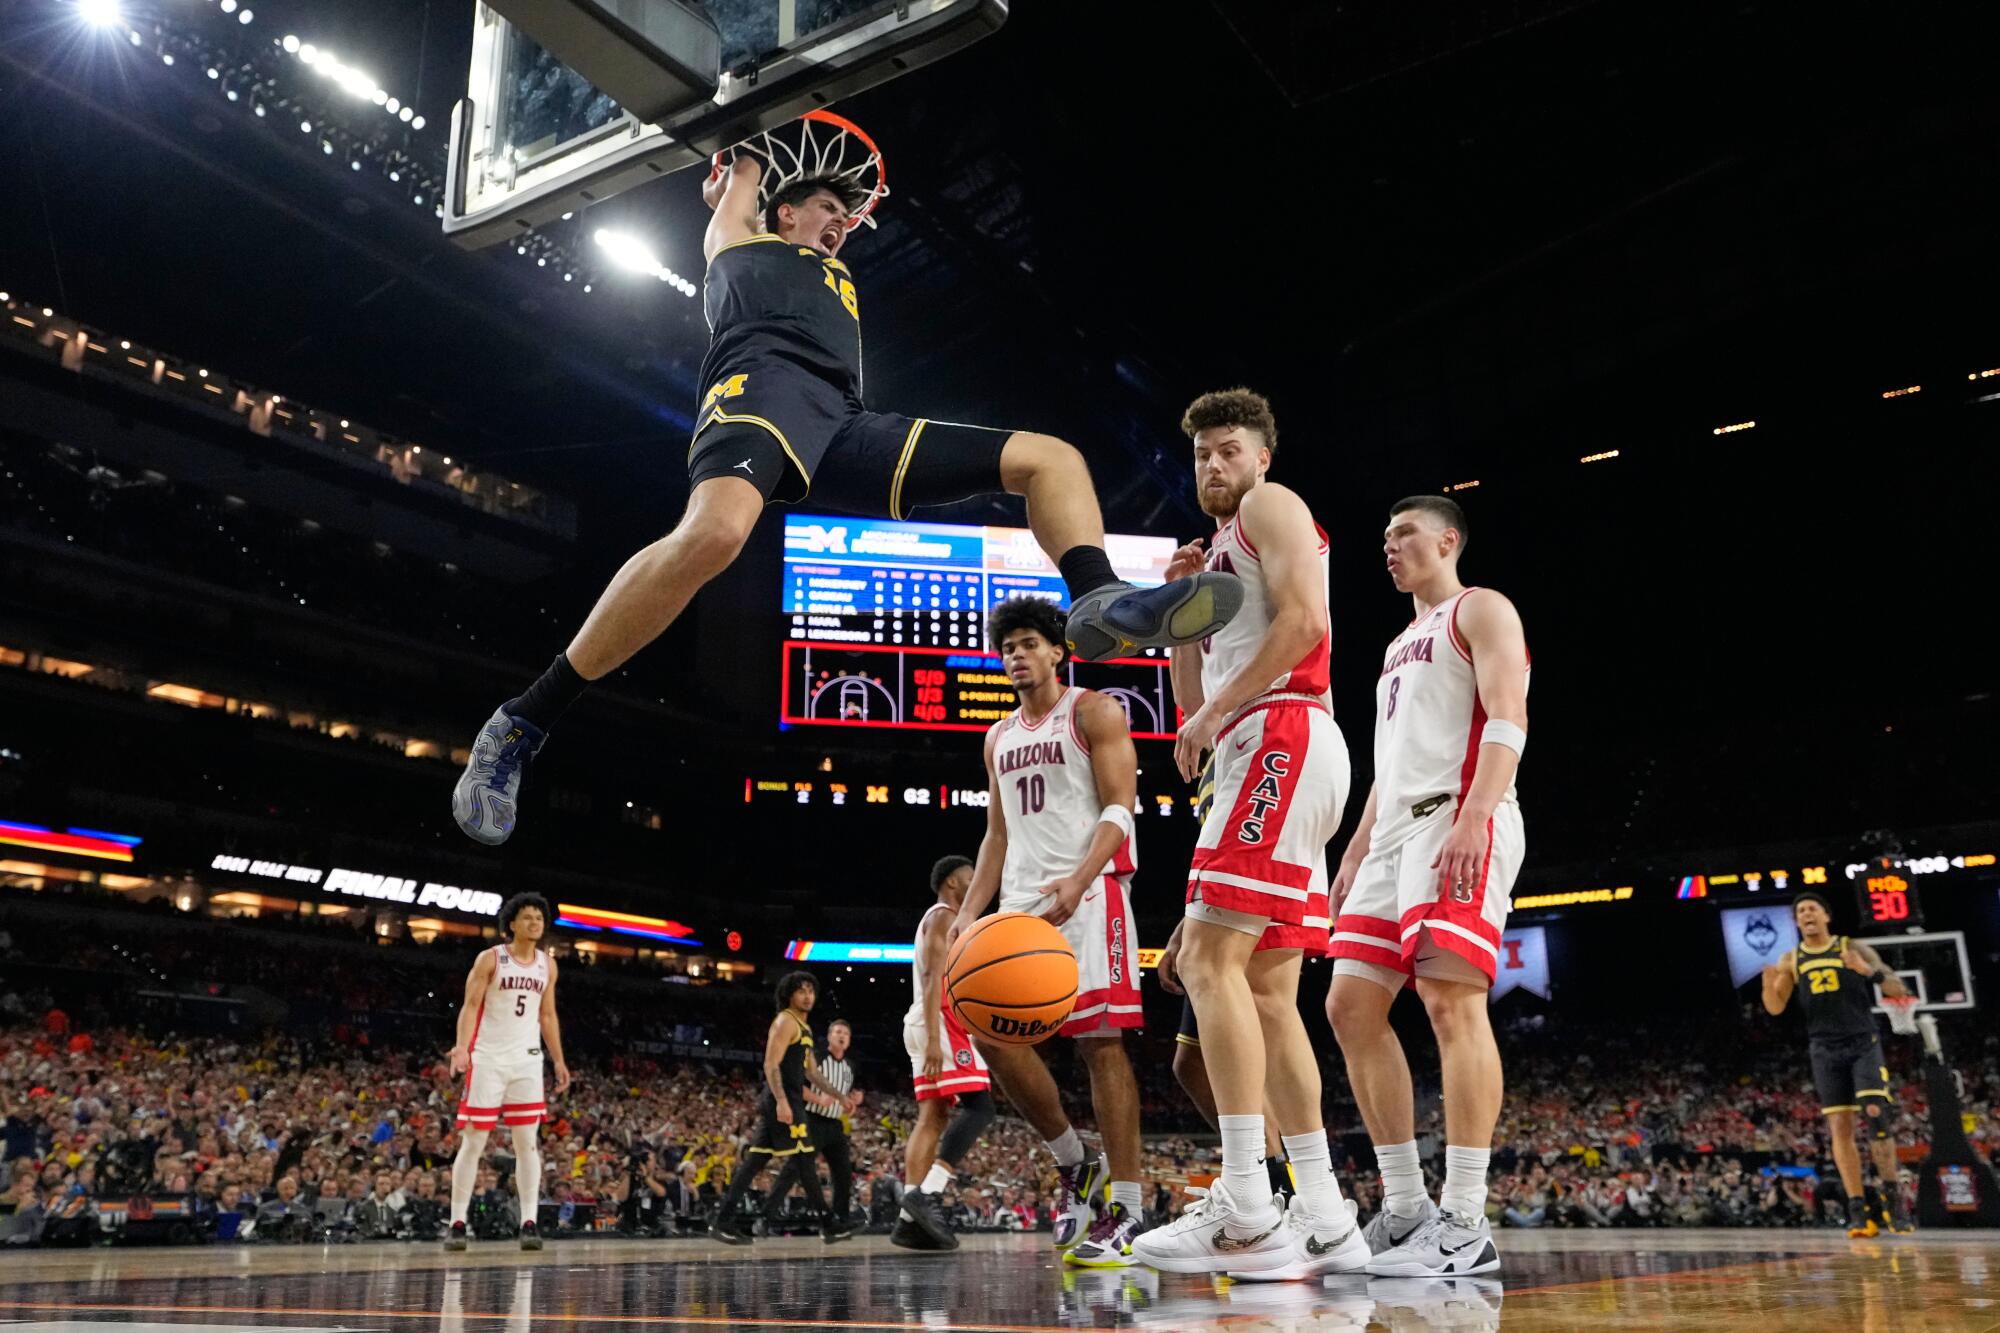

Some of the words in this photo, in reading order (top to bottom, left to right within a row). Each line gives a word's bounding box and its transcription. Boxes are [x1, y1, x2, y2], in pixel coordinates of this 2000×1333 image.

[704, 374, 748, 411] M
[1000, 741, 1066, 776] ARIZONA
[904, 788, 931, 804] 62
[1016, 773, 1045, 816] 10
[1239, 751, 1291, 844] CATS
[322, 867, 417, 903] FINAL
[417, 882, 503, 916] FOUR
[1870, 891, 1909, 921] 30
[1111, 917, 1122, 984] CATS
[1808, 968, 1840, 995] 23
[515, 994, 527, 1018] 5
